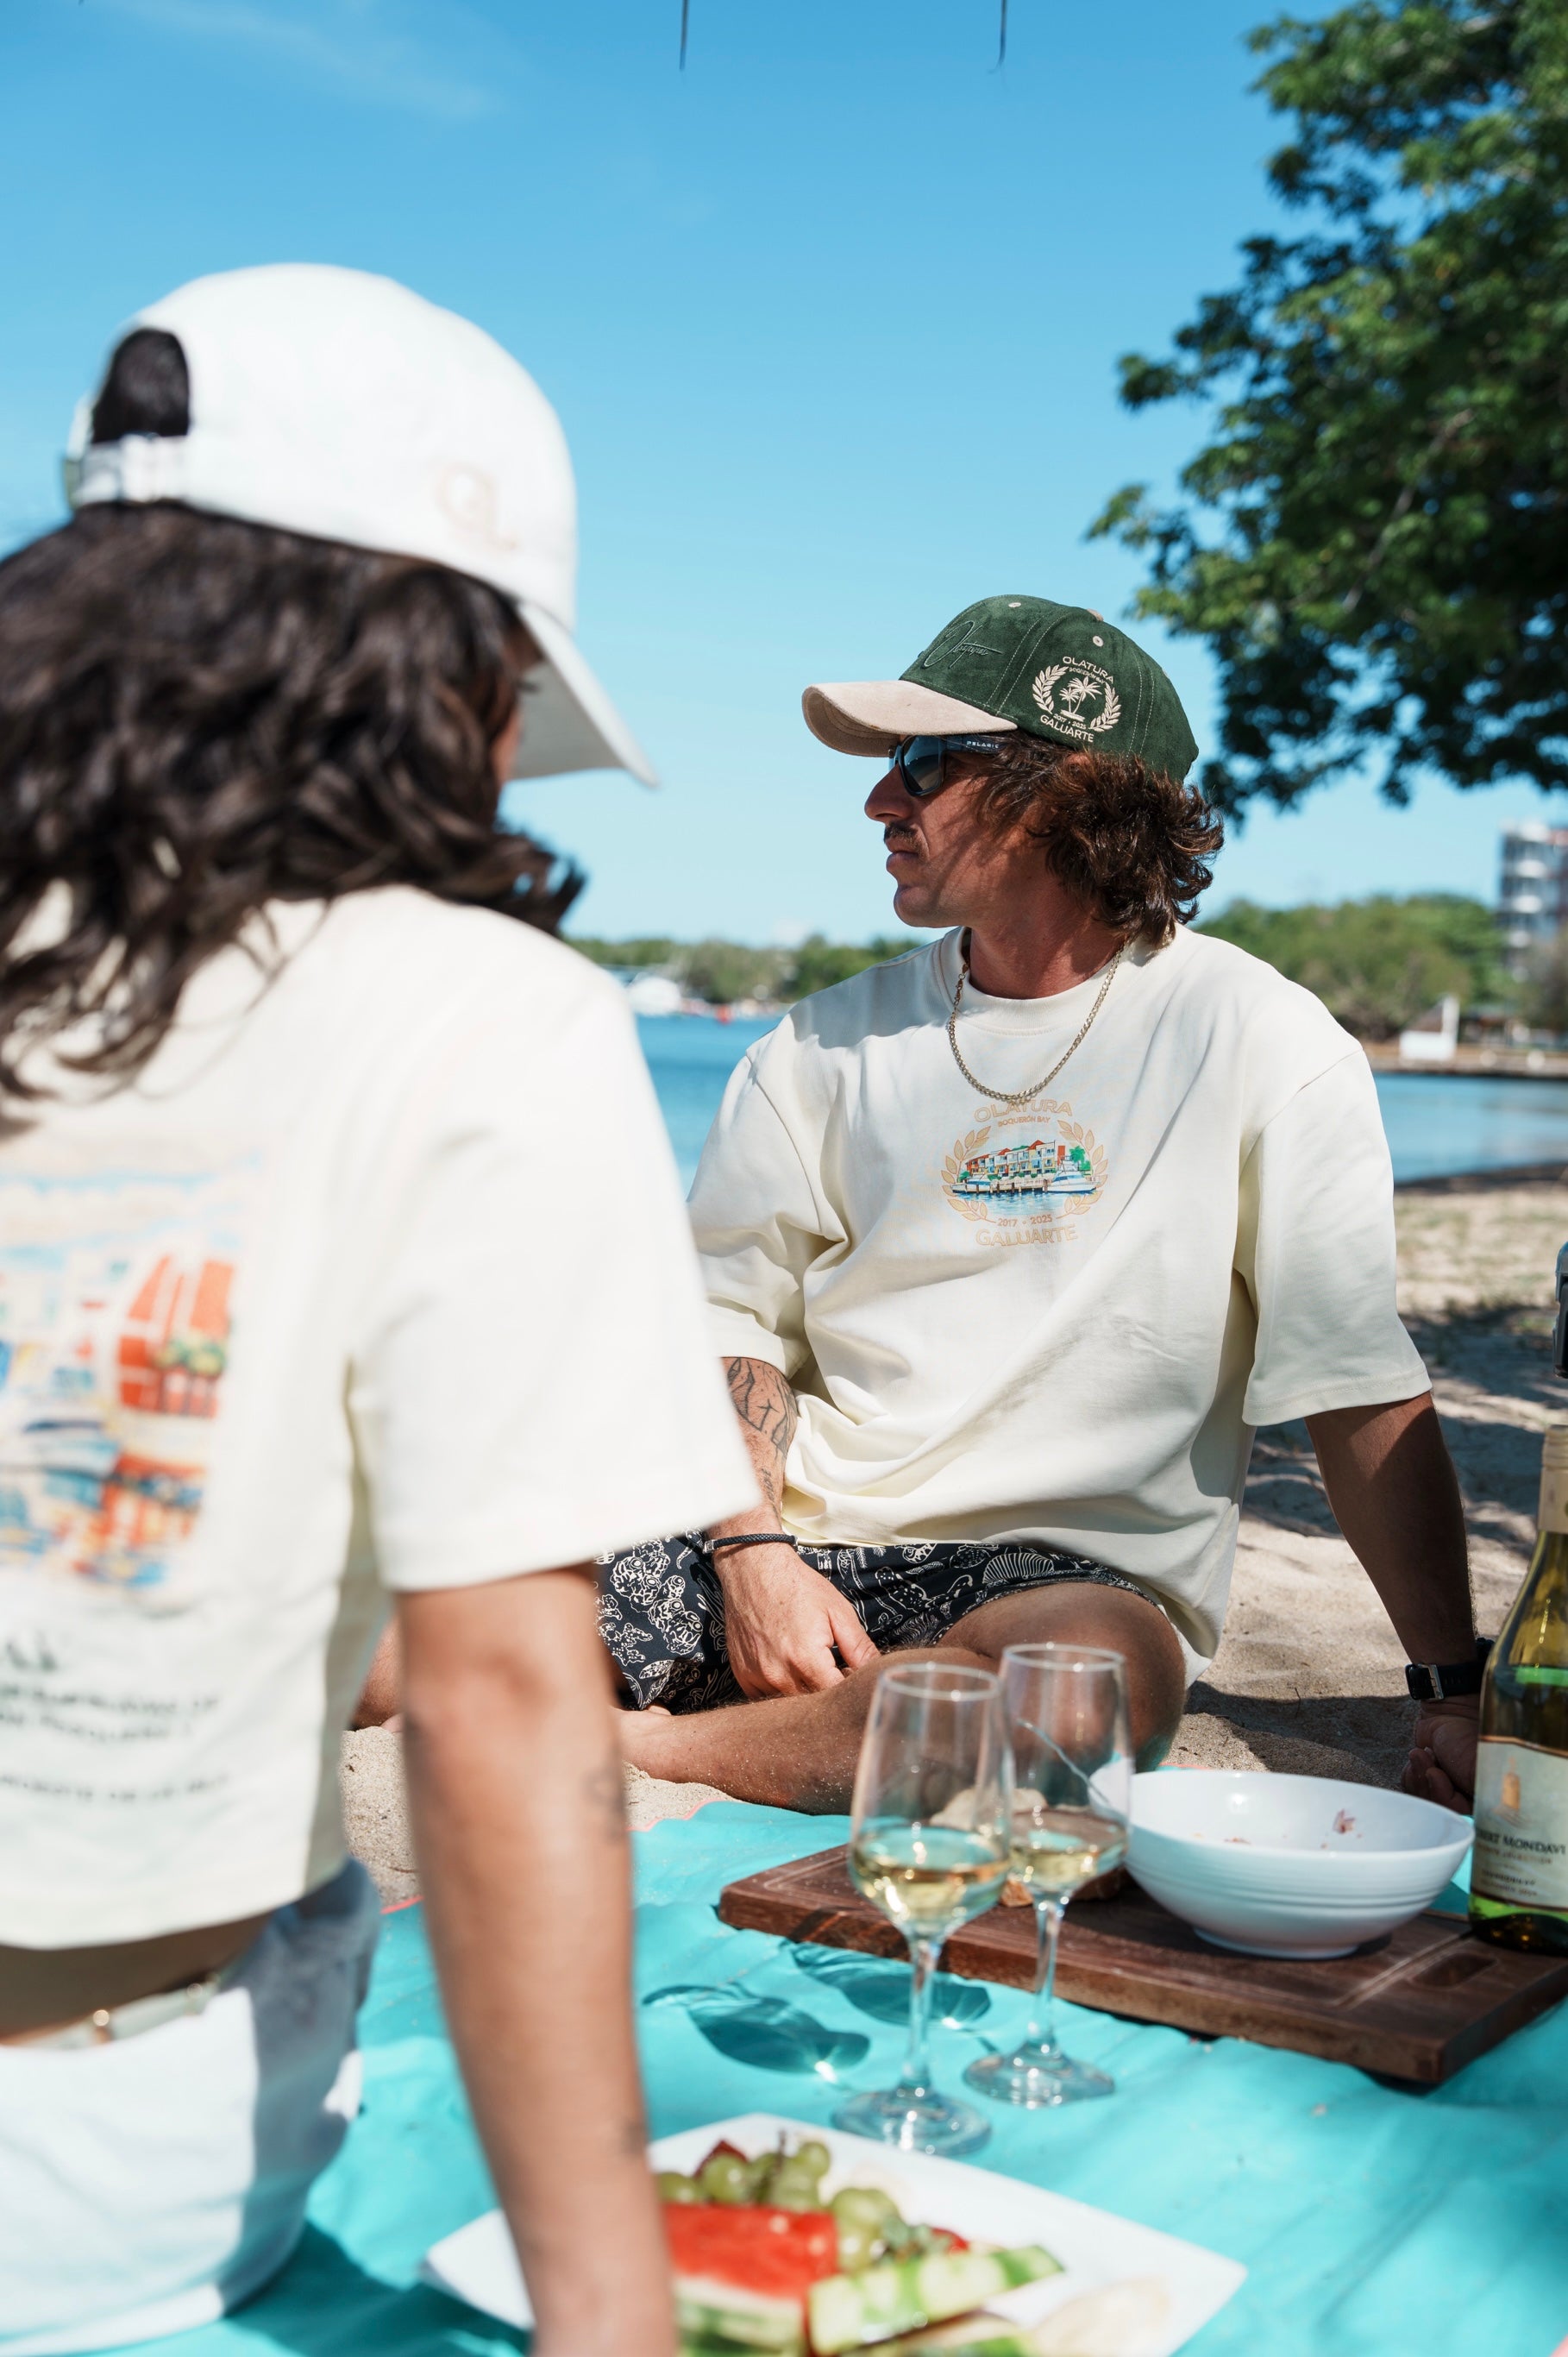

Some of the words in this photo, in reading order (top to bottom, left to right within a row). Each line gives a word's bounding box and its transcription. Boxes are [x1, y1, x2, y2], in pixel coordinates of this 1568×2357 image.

[1063, 656, 1113, 684] OLATURA
[1040, 714, 1094, 743] GALUARTE
[1053, 713, 1067, 723] 2017
[966, 740, 1000, 749] PELAGIC
[975, 1098, 1073, 1122] OLATURA
[997, 1217, 1018, 1227] 2017
[1030, 1214, 1053, 1225] 2025
[975, 1223, 1078, 1246] GALUARTE
[1503, 1835, 1566, 1855] MONDAVI
